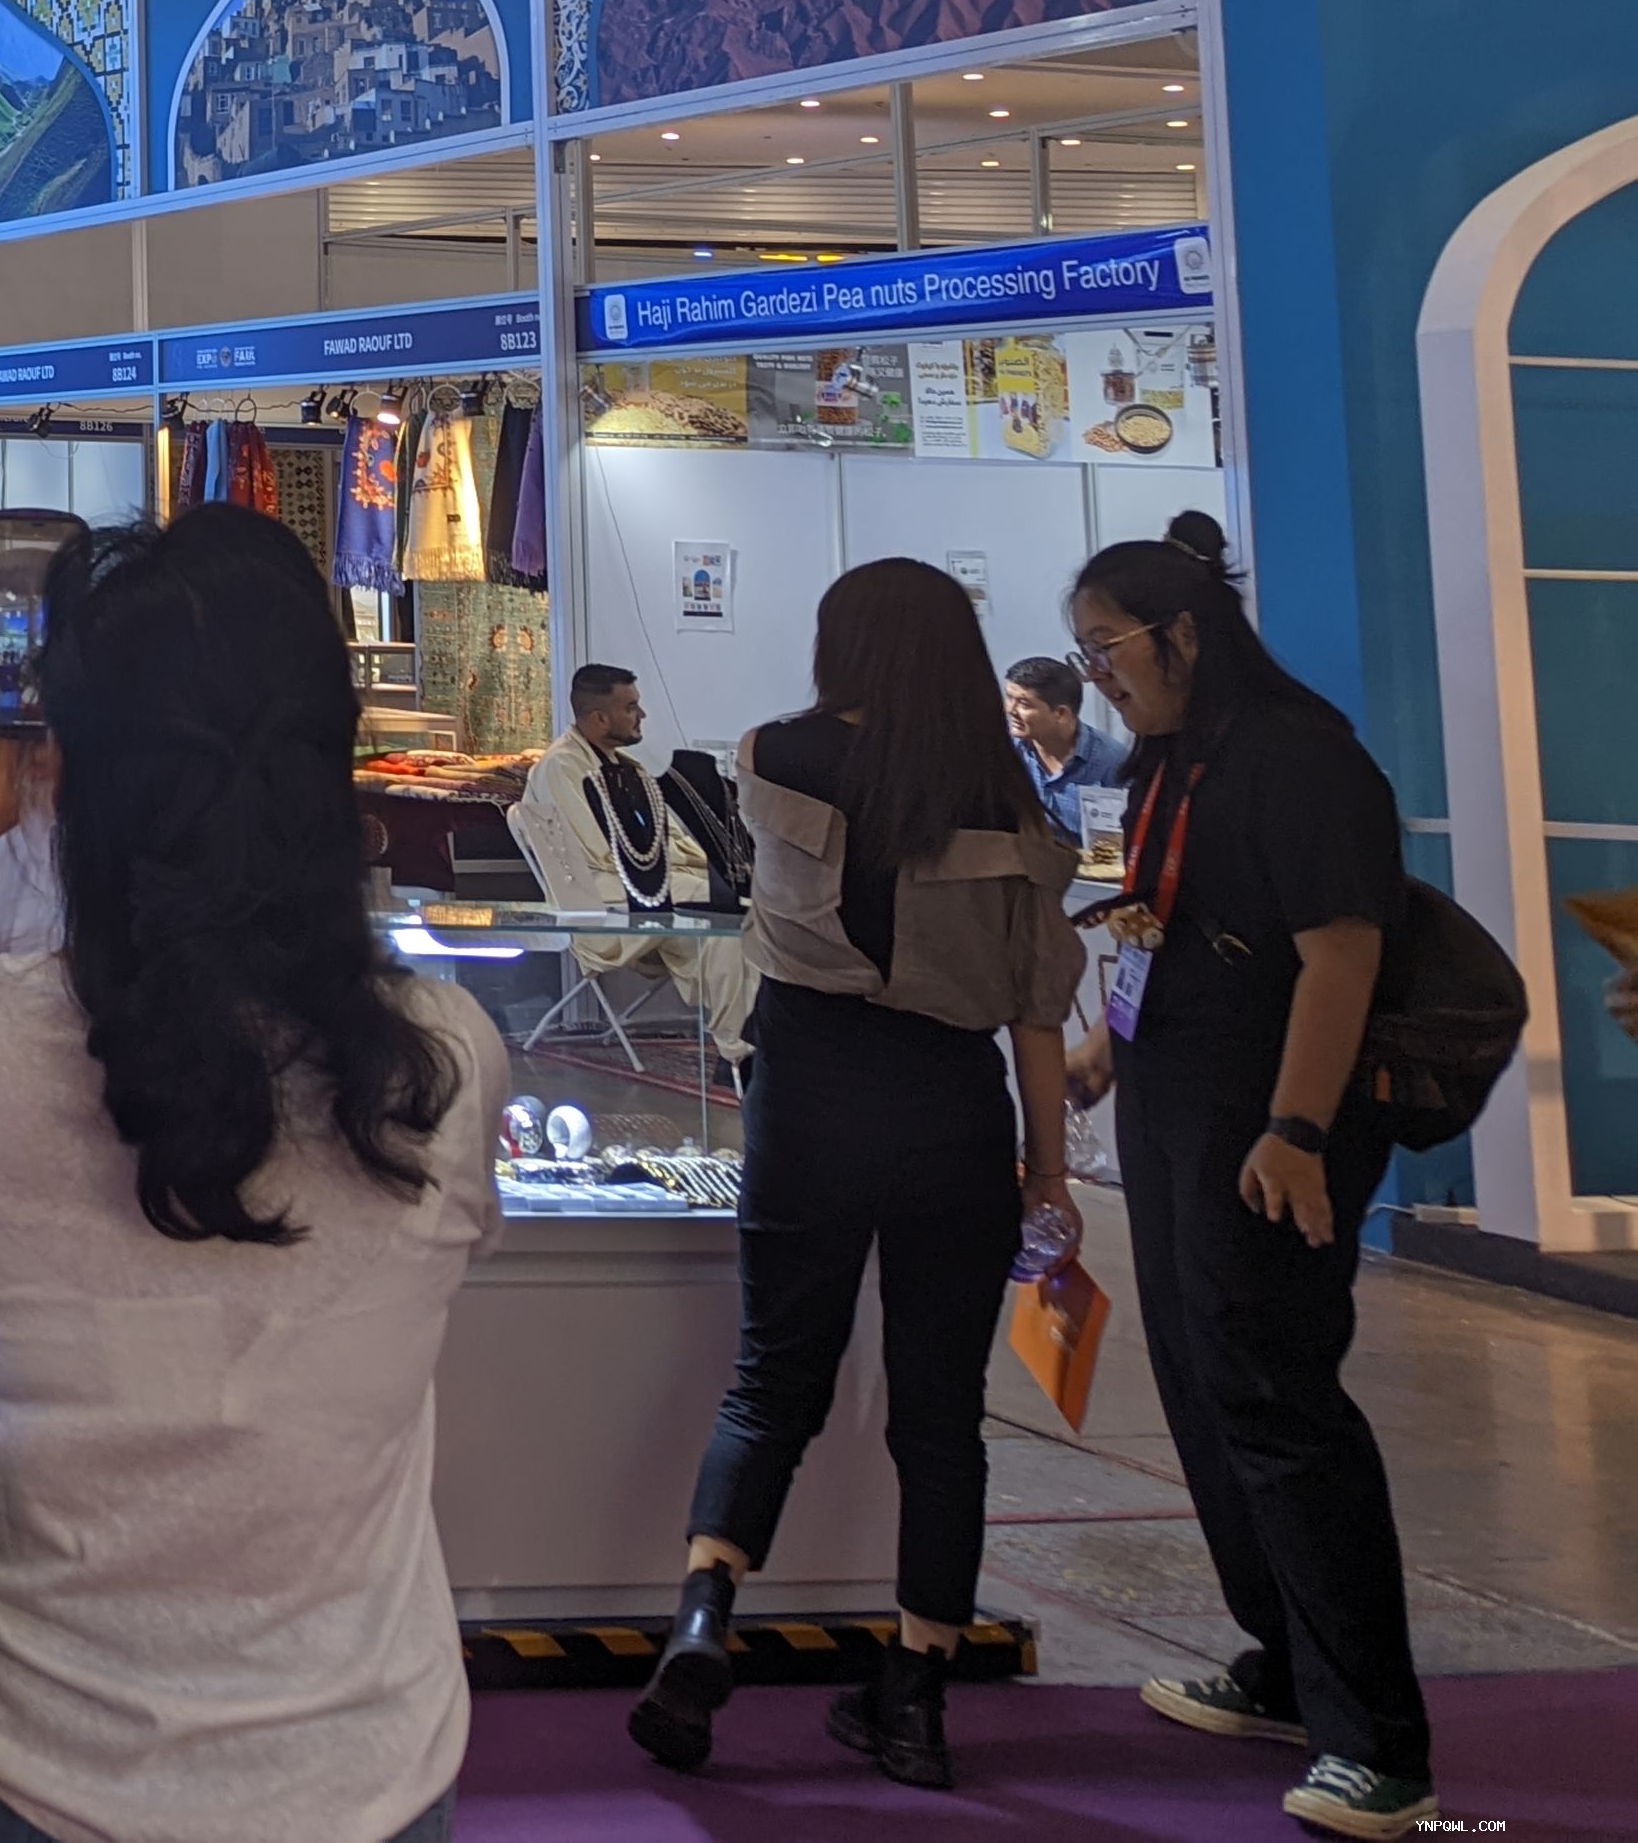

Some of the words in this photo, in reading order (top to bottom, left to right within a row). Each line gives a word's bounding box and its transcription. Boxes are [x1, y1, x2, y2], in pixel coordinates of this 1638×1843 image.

[637, 300, 672, 331] Haji
[676, 293, 736, 324] Rahim
[740, 285, 818, 318] Gardezi
[823, 282, 865, 311] Pea
[870, 277, 918, 307] nuts
[924, 264, 1057, 301] Processing
[1062, 257, 1160, 292] Factory
[324, 336, 358, 357] FAWAD
[359, 333, 393, 354] RAOUF
[394, 332, 413, 351] LTD
[500, 331, 537, 351] 8B123
[17, 365, 41, 382] RAOUF
[41, 364, 55, 380] LTD
[112, 365, 138, 383] 8B124
[79, 421, 114, 432] 8B126
